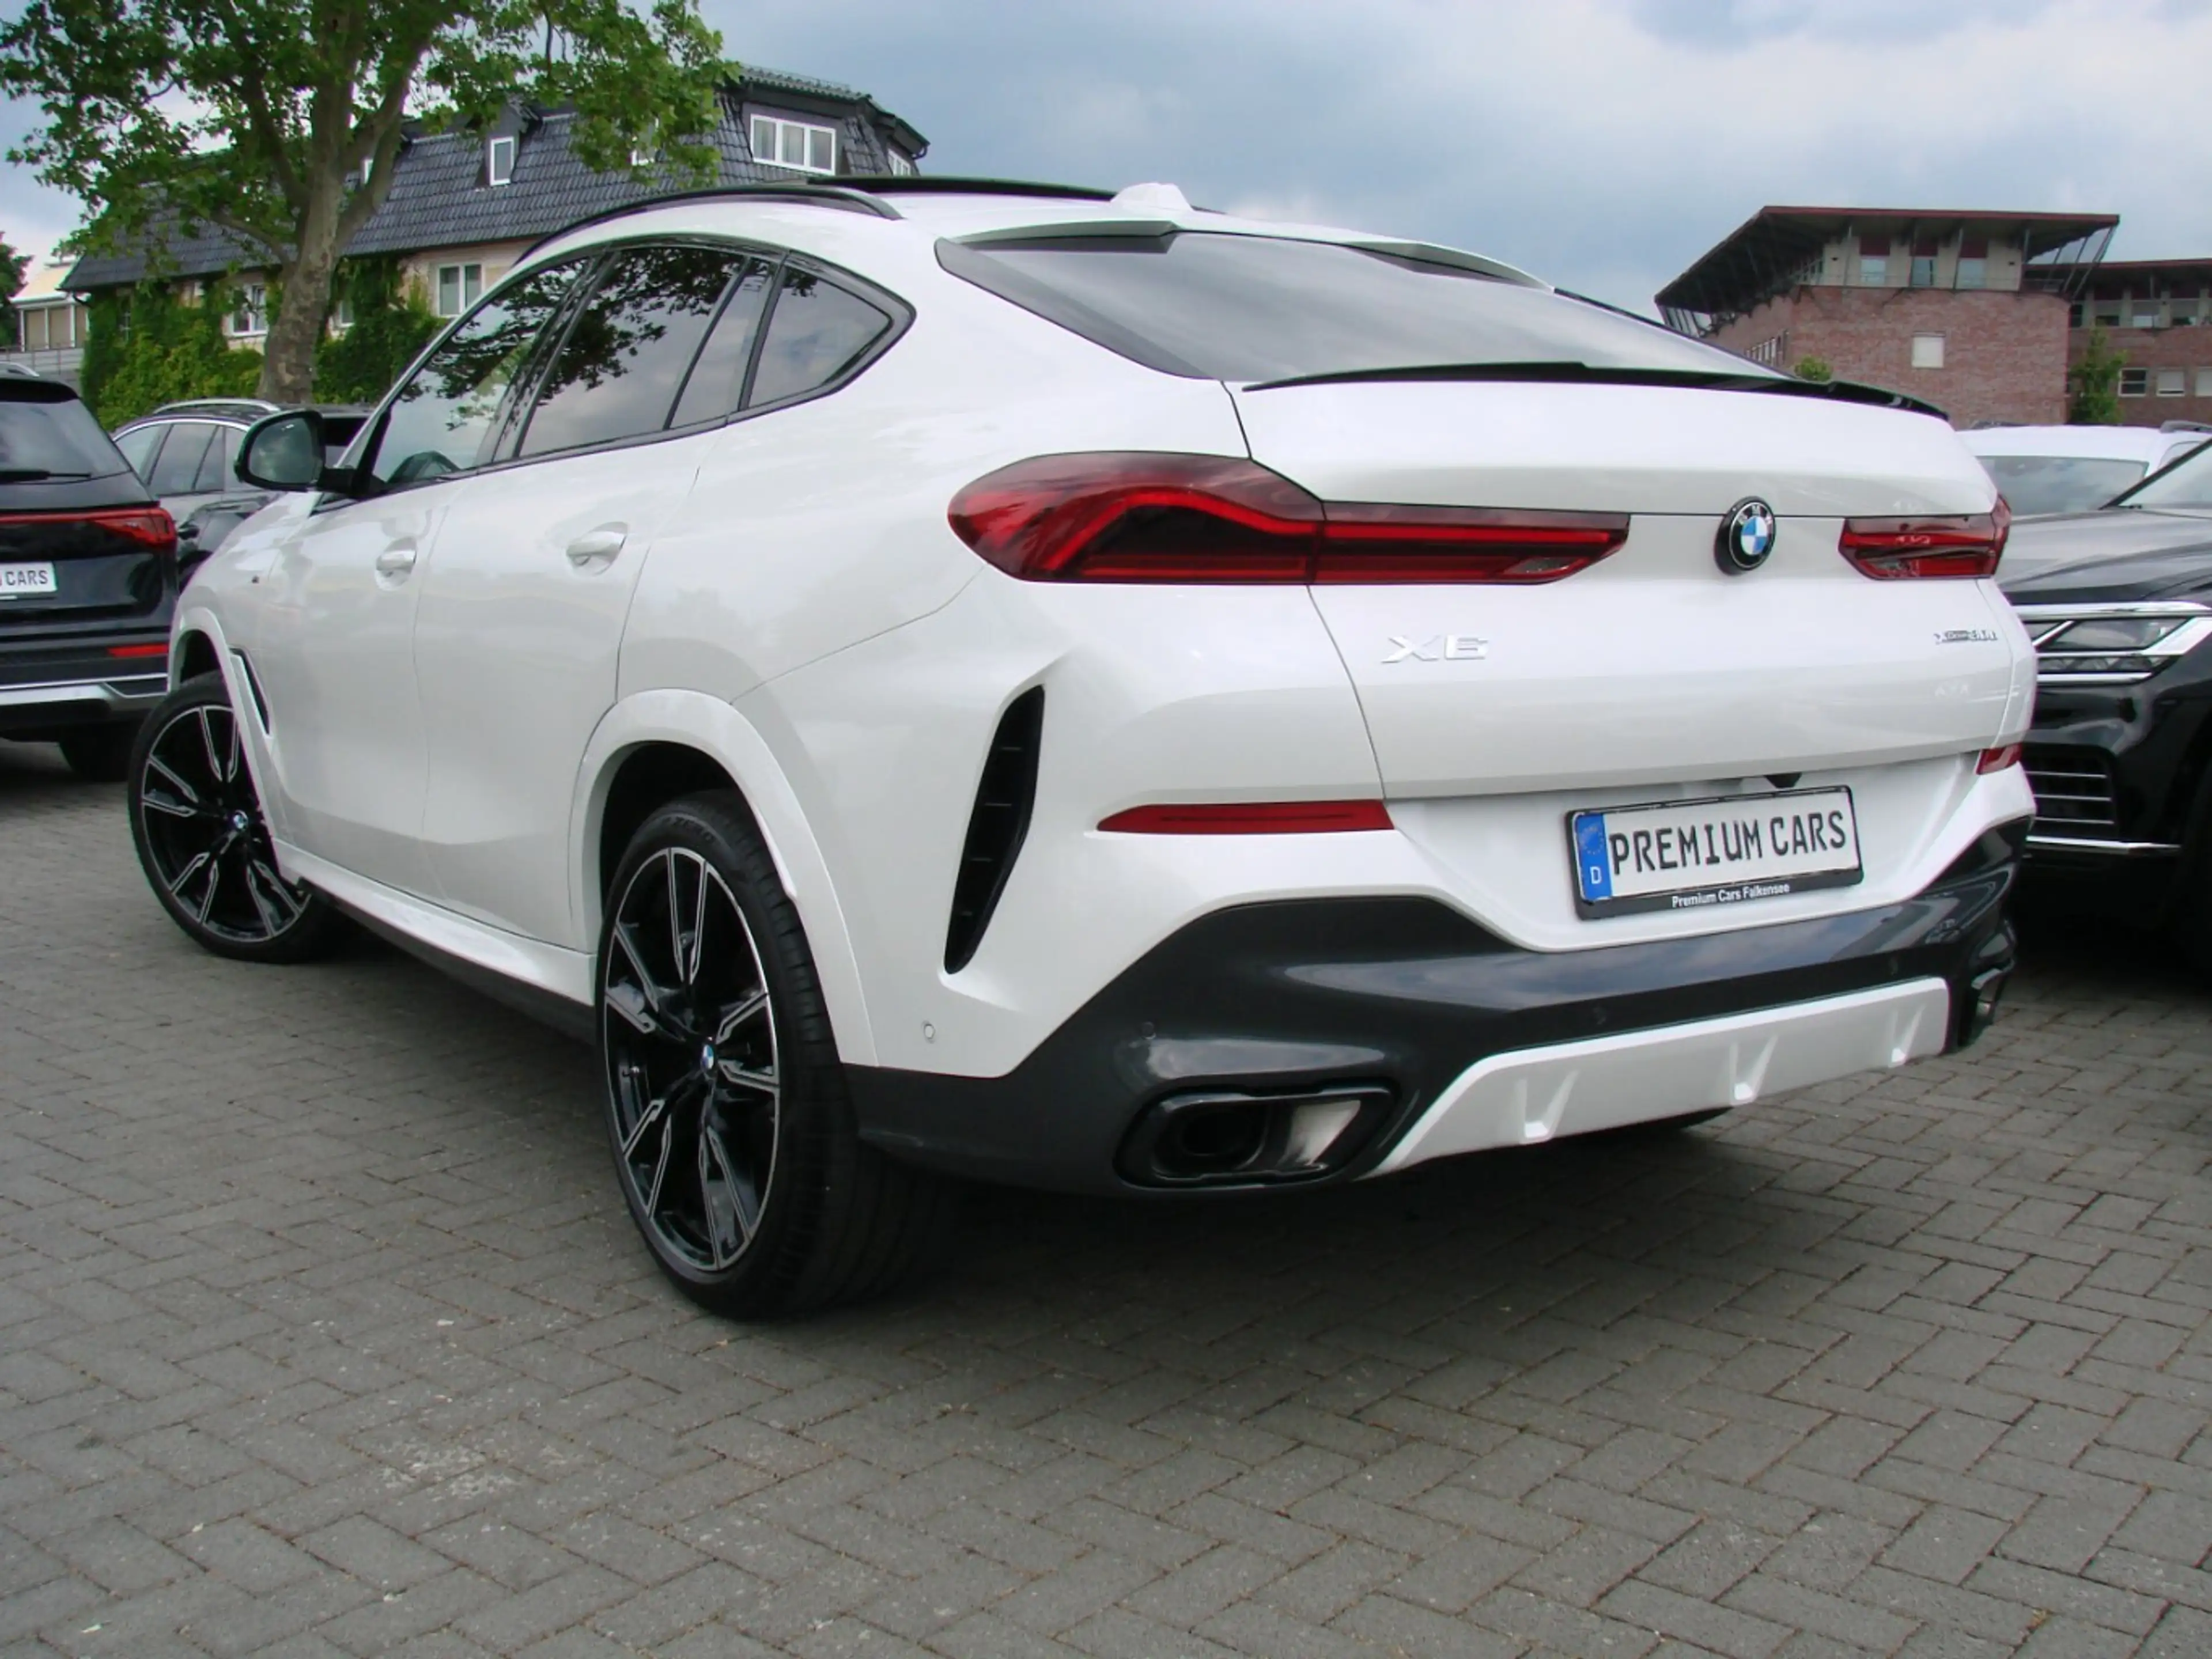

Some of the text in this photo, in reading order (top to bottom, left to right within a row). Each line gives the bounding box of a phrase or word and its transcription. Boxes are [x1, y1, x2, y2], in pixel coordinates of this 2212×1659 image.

[5, 570, 48, 586] CARS
[1380, 634, 1489, 663] X6
[1609, 810, 1846, 876] PREMIUM CARS
[1590, 866, 1602, 885] D
[1672, 883, 1790, 908] Premium Cars Falkensee
